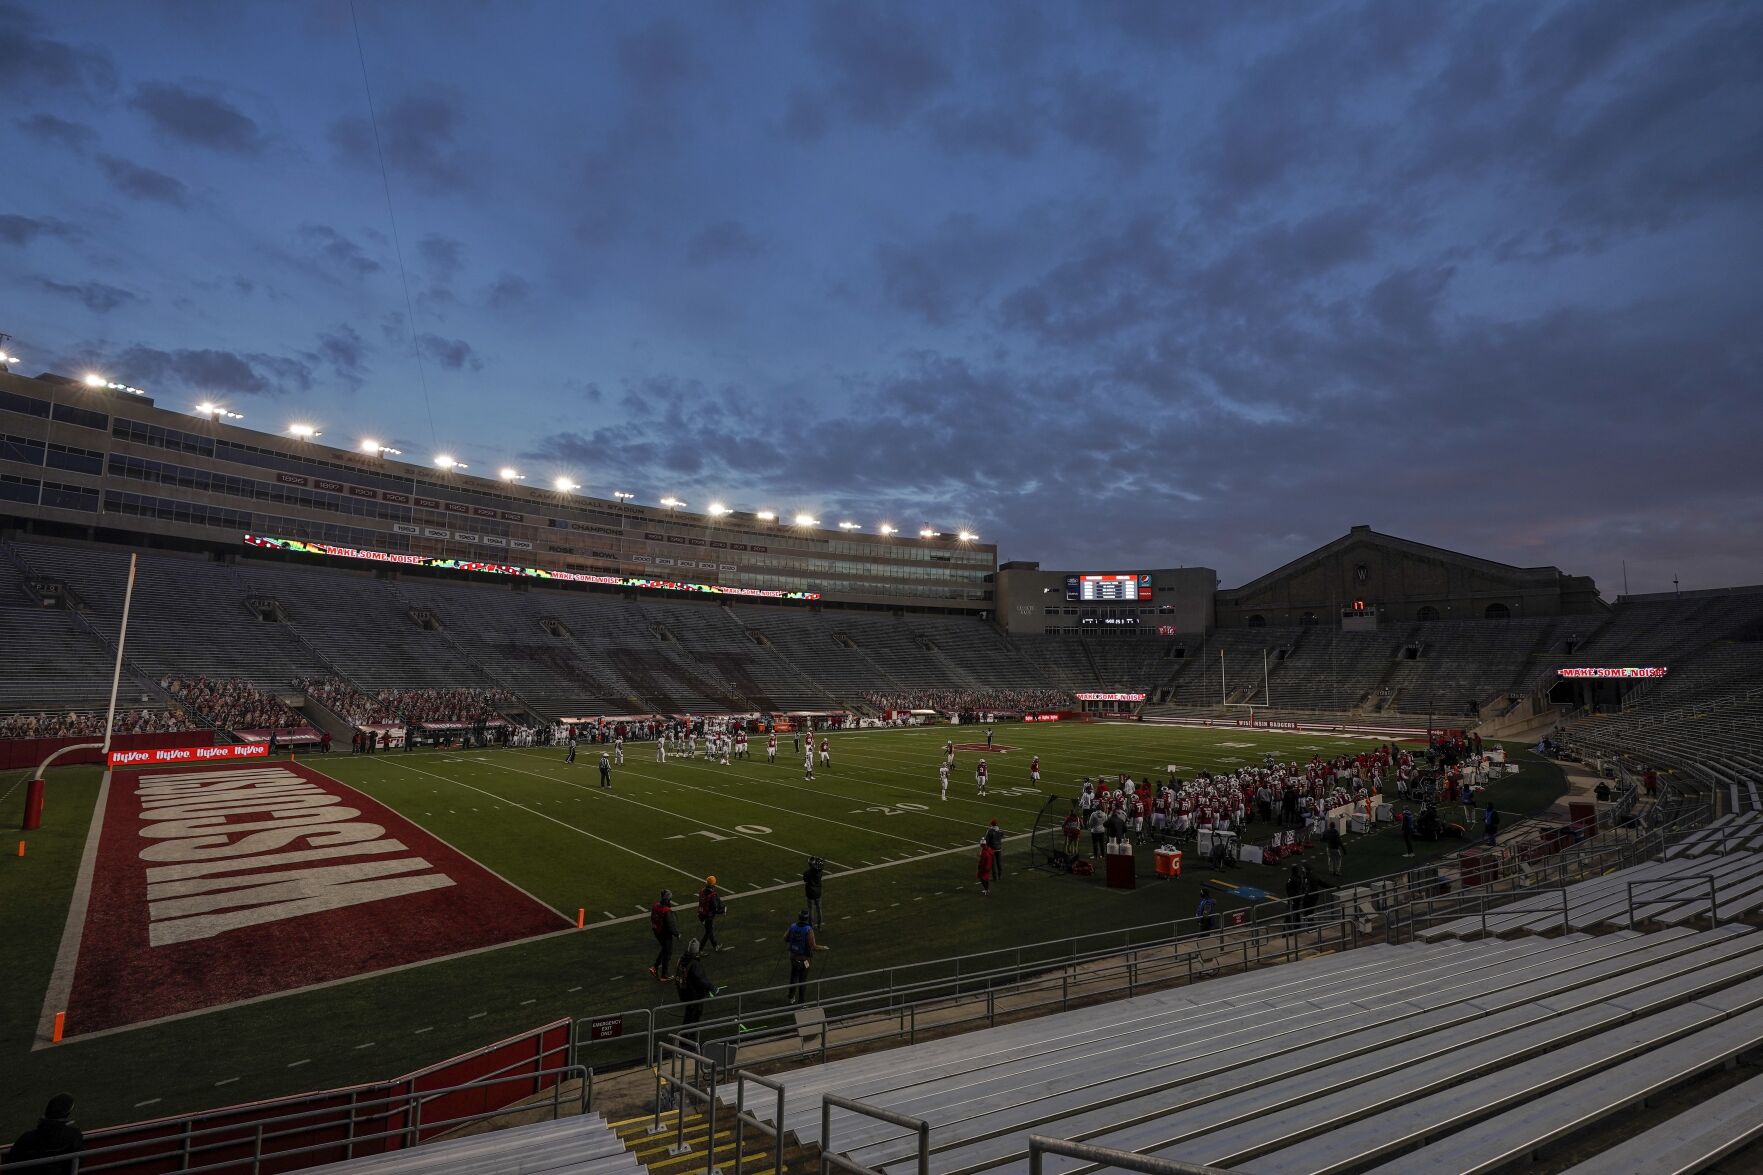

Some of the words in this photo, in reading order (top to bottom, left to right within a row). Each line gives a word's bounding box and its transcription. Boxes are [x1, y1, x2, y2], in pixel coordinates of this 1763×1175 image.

[320, 482, 340, 490] 1897
[354, 488, 373, 497] 1901
[386, 494, 406, 502] 1906
[449, 504, 466, 512] 1952
[608, 504, 644, 514] STADIUM
[571, 523, 624, 536] CHAMPIONS
[487, 537, 503, 545] 1994
[327, 546, 356, 557] MAKE
[360, 550, 387, 560] SOME
[390, 553, 419, 564] NOISE
[549, 545, 575, 554] ROSE
[592, 551, 618, 560] BOWL
[552, 571, 573, 580] MAKE
[575, 574, 596, 582] SOME
[1357, 568, 1367, 580] W
[1598, 668, 1627, 677] SOME
[1631, 669, 1663, 678] NOISE
[1238, 720, 1268, 728] WISNSIN
[1269, 721, 1295, 729] BADGERS
[156, 750, 190, 761] HyVee
[196, 748, 228, 758] HyVee
[234, 746, 264, 756] HyVee
[112, 752, 149, 763] HyVee
[865, 802, 930, 816] 20
[688, 823, 774, 843] 10
[134, 767, 458, 948] WISCONSIN
[1172, 857, 1180, 870] G
[592, 1019, 622, 1028] EMERGENCY
